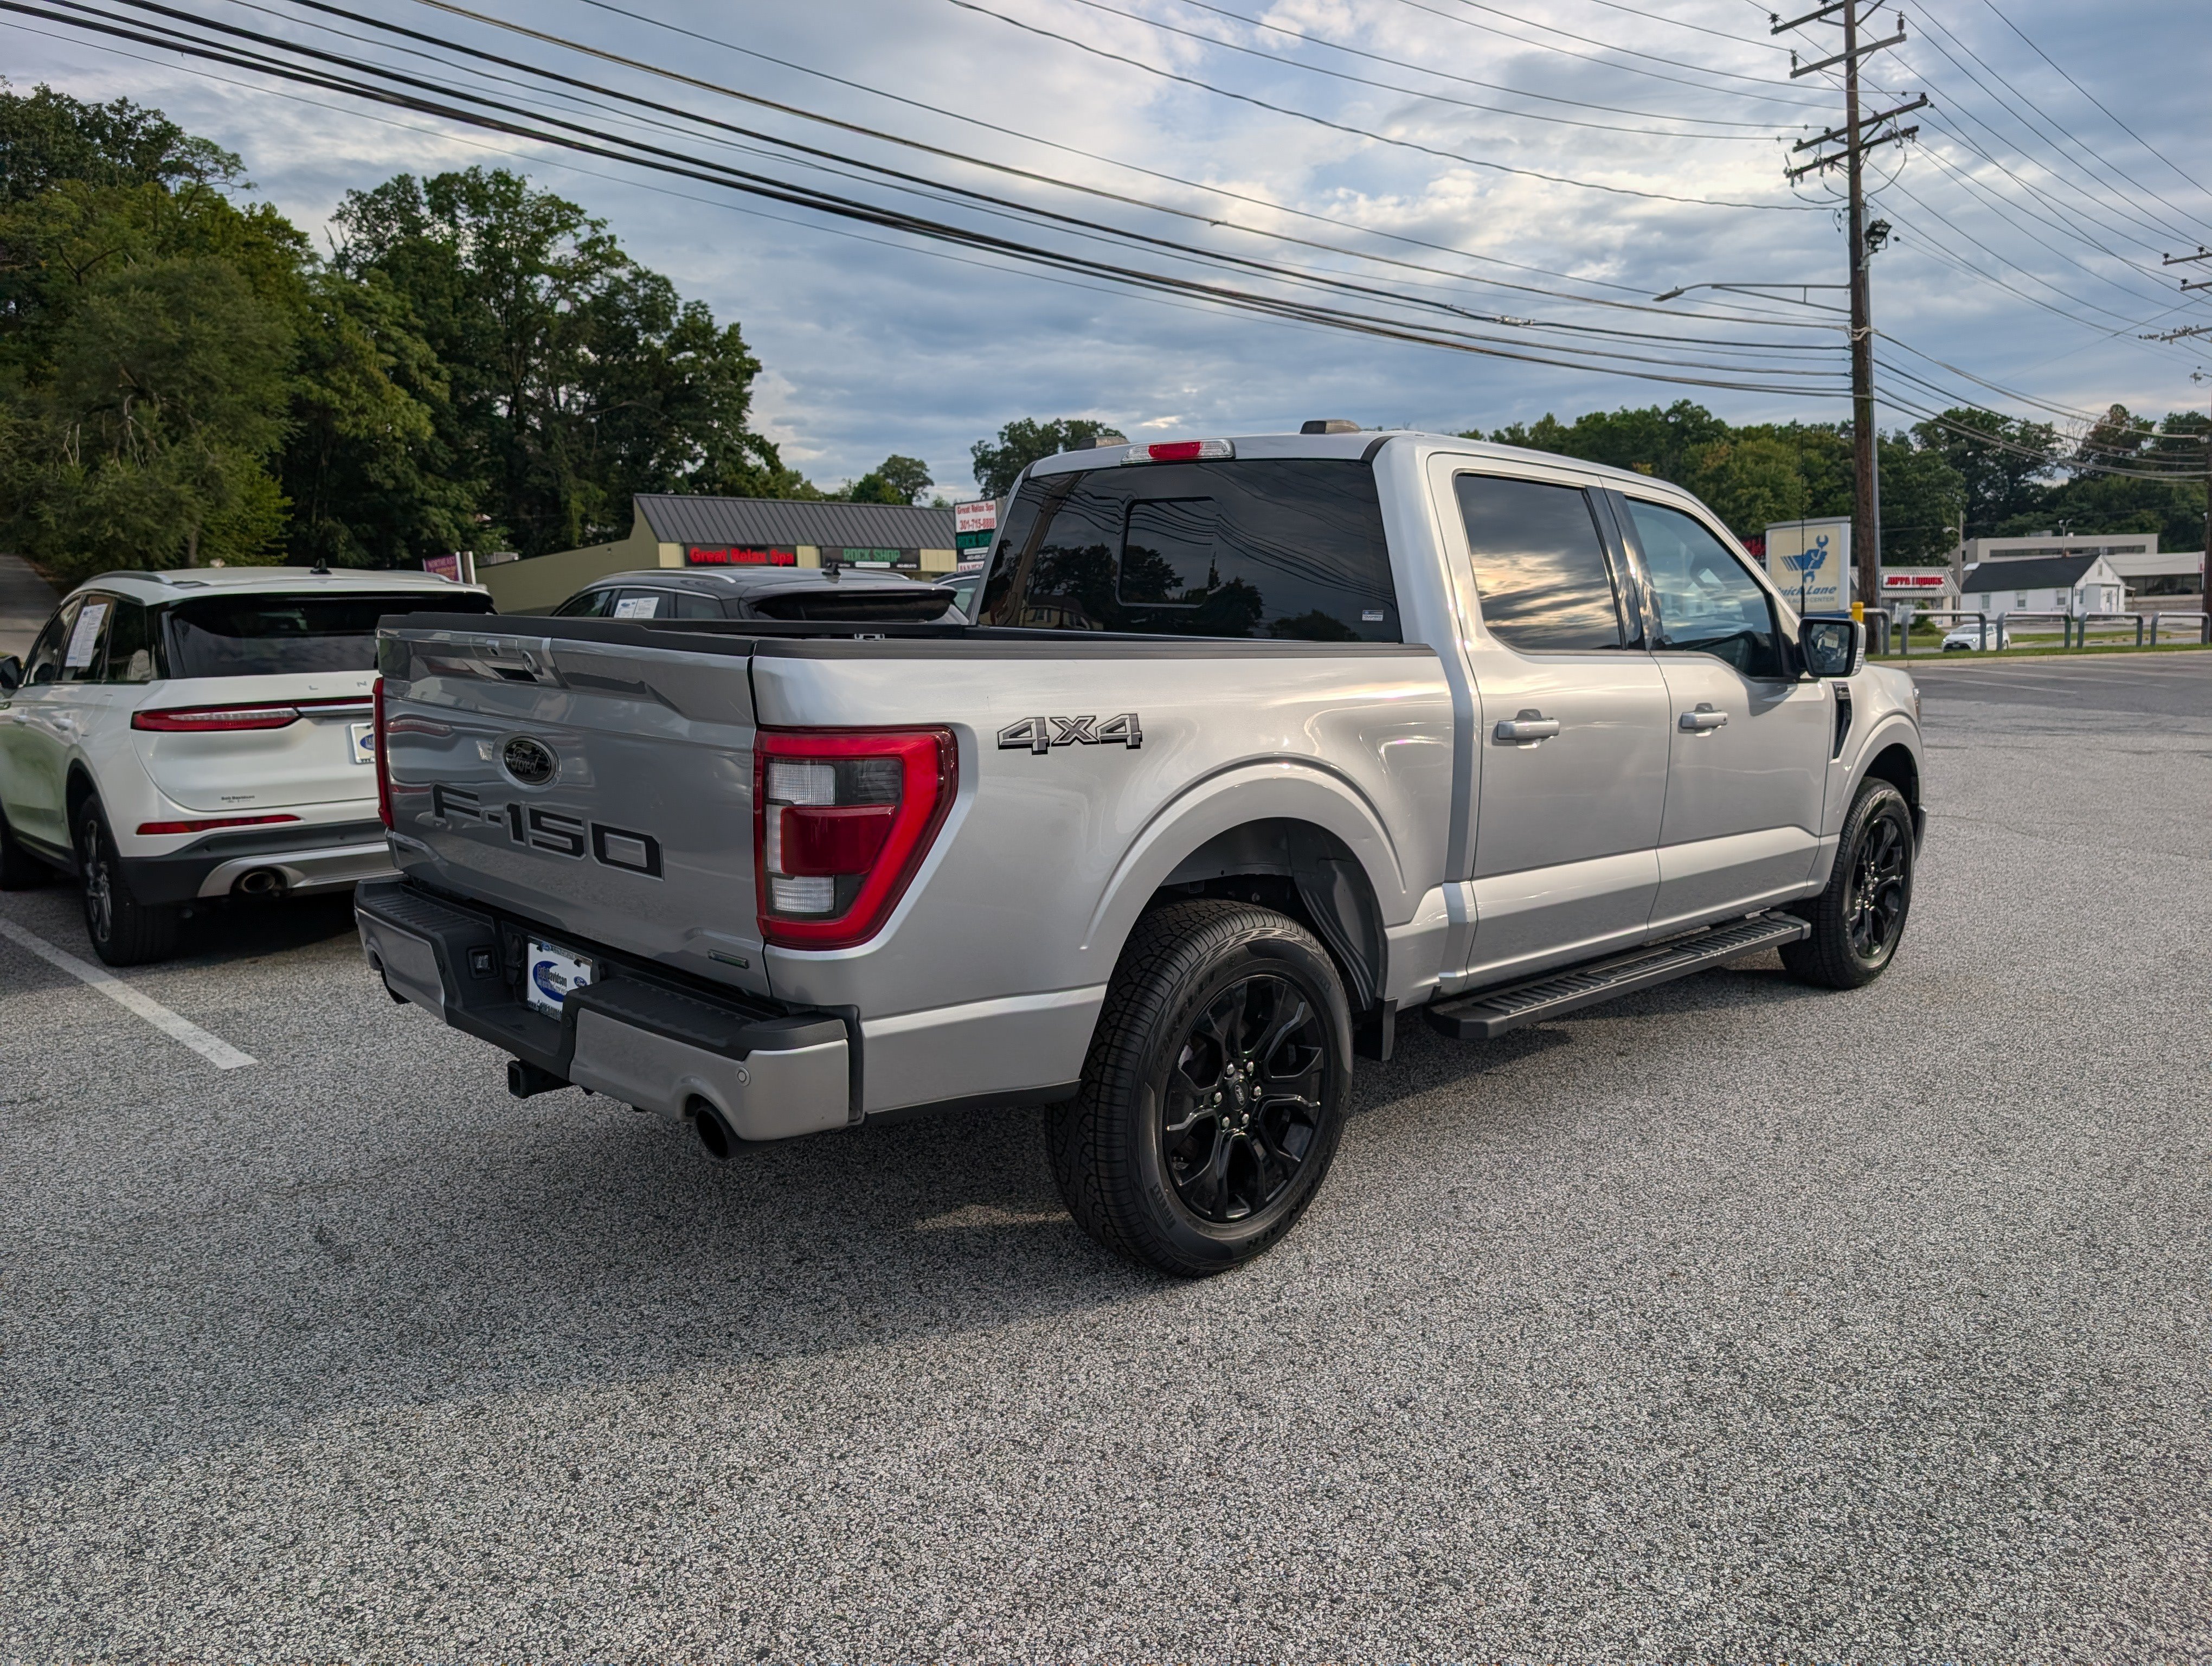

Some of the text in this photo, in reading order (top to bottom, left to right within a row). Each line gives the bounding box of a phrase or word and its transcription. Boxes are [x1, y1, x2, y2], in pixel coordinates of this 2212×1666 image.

[690, 547, 794, 567] Great Relax Spa
[843, 548, 901, 562] ROCK SHOP
[1806, 585, 1837, 594] Lane
[506, 746, 541, 775] Ford
[432, 781, 665, 881] F-150
[547, 967, 567, 988] Davidson
